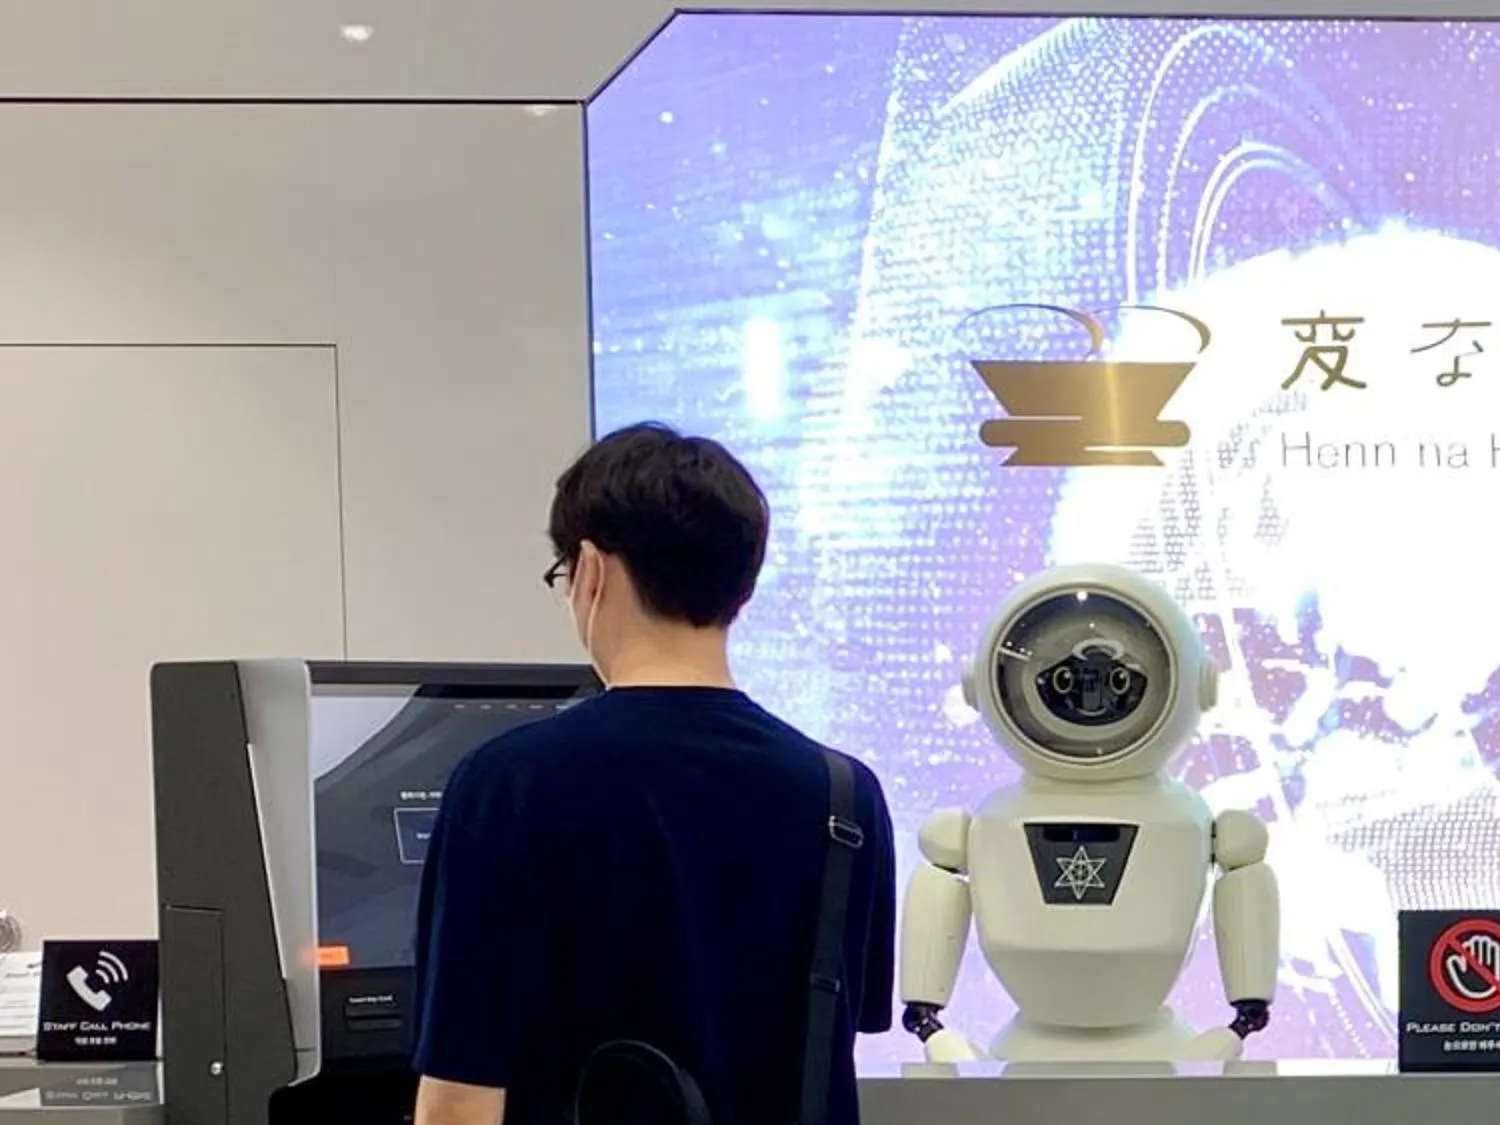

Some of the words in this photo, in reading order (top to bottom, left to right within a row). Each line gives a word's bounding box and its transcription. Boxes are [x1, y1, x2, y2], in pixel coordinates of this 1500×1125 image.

[1281, 431, 1396, 469] Henn
[1418, 442, 1470, 469] na
[79, 1021, 108, 1031] CALL
[111, 1021, 151, 1031] PHONE
[1406, 1021, 1456, 1033] PLEASE
[1459, 1021, 1500, 1033] DON'T
